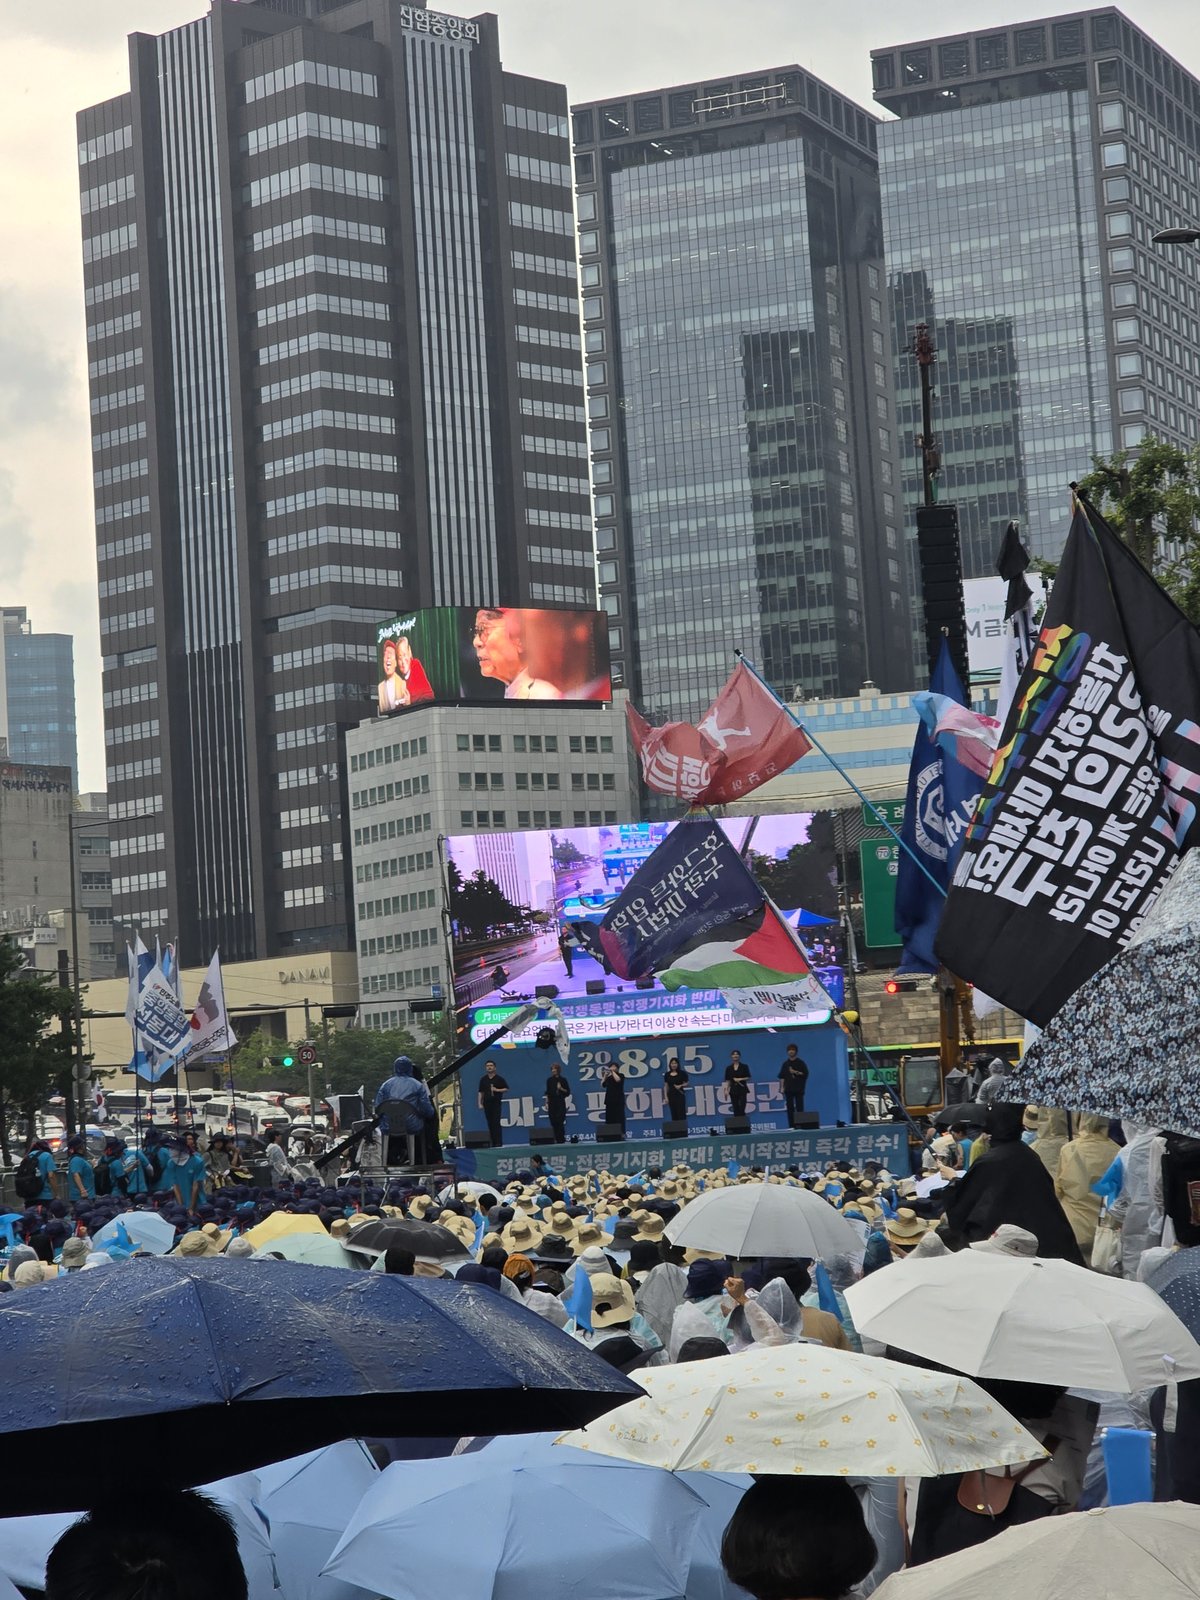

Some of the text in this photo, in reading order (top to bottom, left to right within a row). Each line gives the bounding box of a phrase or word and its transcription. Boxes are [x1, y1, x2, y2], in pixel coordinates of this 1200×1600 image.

[400, 5, 480, 44] 신협중앙회
[966, 618, 1008, 638] M금
[278, 967, 330, 985] DANAM
[159, 988, 182, 1007] 민주노
[691, 989, 721, 1004] 반대!
[819, 974, 838, 987] 수!
[137, 1008, 181, 1046] 선봉대
[588, 1021, 608, 1033] 가라
[610, 1019, 641, 1032] 나가라
[643, 1017, 653, 1029] 더
[655, 1016, 676, 1029] 이상
[678, 1016, 689, 1028] 안
[691, 1013, 721, 1026] 속는다
[302, 1052, 312, 1060] 50
[578, 1051, 612, 1066] 20
[671, 1146, 713, 1166] 반대!
[720, 1139, 810, 1162] 전시작전권
[816, 1137, 851, 1155] 즉각
[857, 1134, 899, 1153] 환수!
